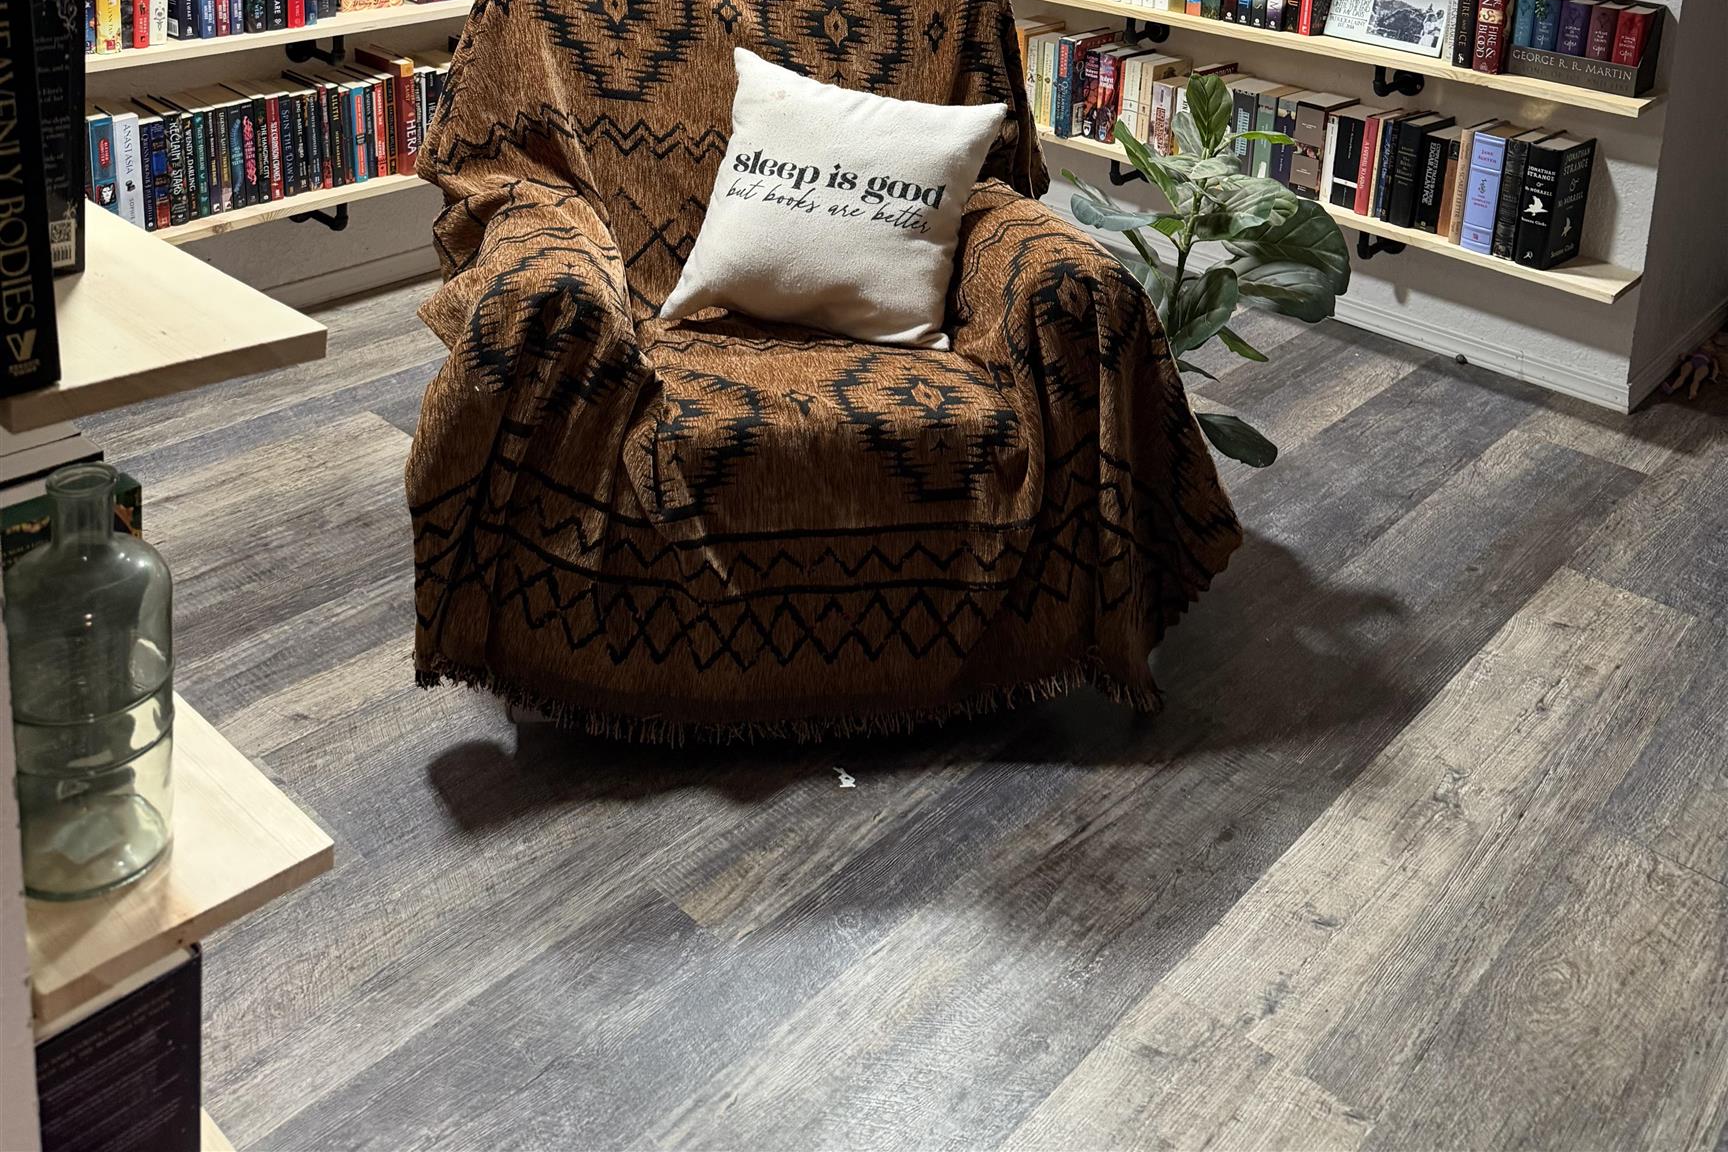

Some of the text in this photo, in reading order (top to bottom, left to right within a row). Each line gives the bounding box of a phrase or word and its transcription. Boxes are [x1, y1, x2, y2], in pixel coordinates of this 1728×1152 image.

[1458, 31, 1468, 47] ICE
[1476, 23, 1488, 59] BLOOD
[1488, 25, 1499, 47] FIRE
[1512, 49, 1555, 67] GEORGE
[1558, 58, 1568, 69] R.
[1571, 61, 1582, 72] R.
[1585, 64, 1633, 82] MARTIN
[281, 108, 289, 131] SPIN
[331, 94, 339, 122] LILITH
[123, 123, 135, 175] ANASTASIA
[168, 122, 181, 162] RECLAIM
[405, 119, 417, 156] HERA
[732, 148, 948, 210] sleep is good
[1526, 170, 1556, 183] STRANGE
[1527, 164, 1557, 177] JONATHAN
[726, 177, 931, 235] but books are better
[0, 194, 37, 325] BODIES
